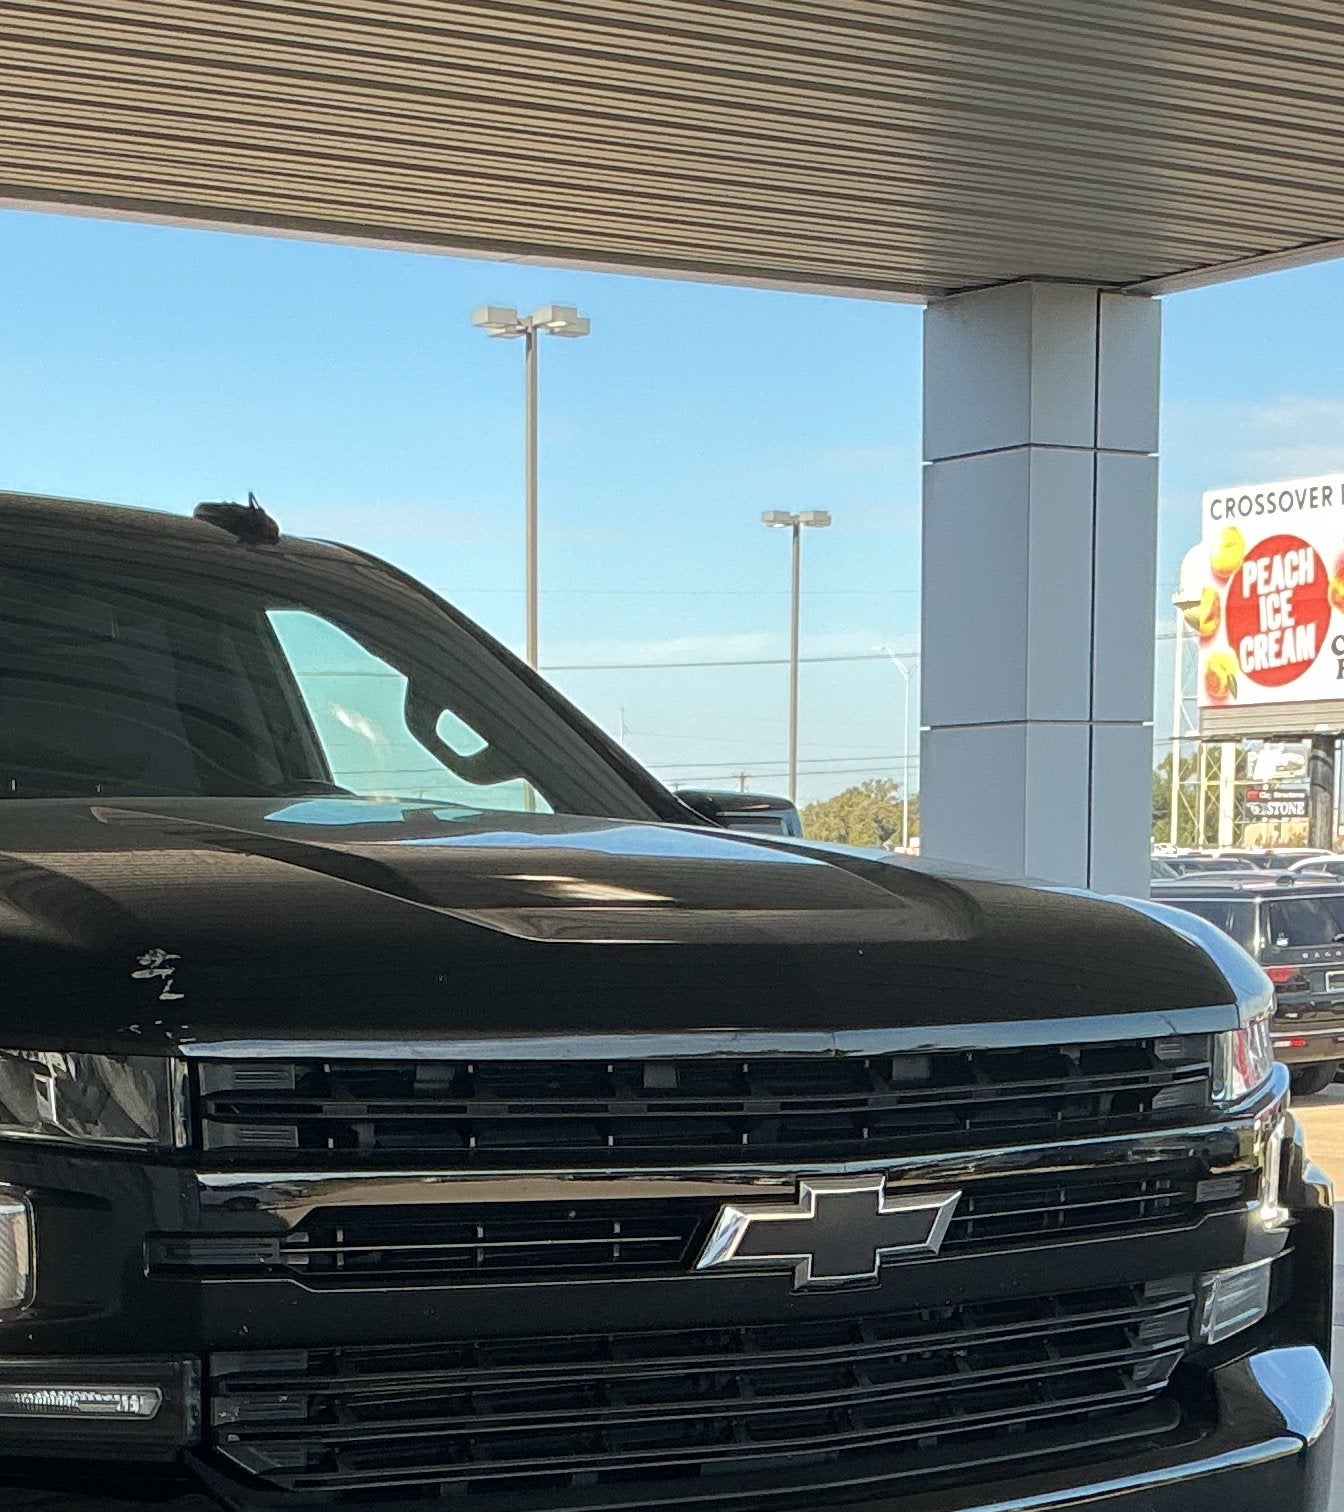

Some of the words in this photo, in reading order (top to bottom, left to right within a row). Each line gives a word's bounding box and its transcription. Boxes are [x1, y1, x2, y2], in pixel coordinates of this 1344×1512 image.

[1210, 485, 1333, 520] CROSSOVER
[1242, 547, 1315, 598] PEACH
[1258, 590, 1295, 632] ICE
[1239, 623, 1317, 673] CREAM
